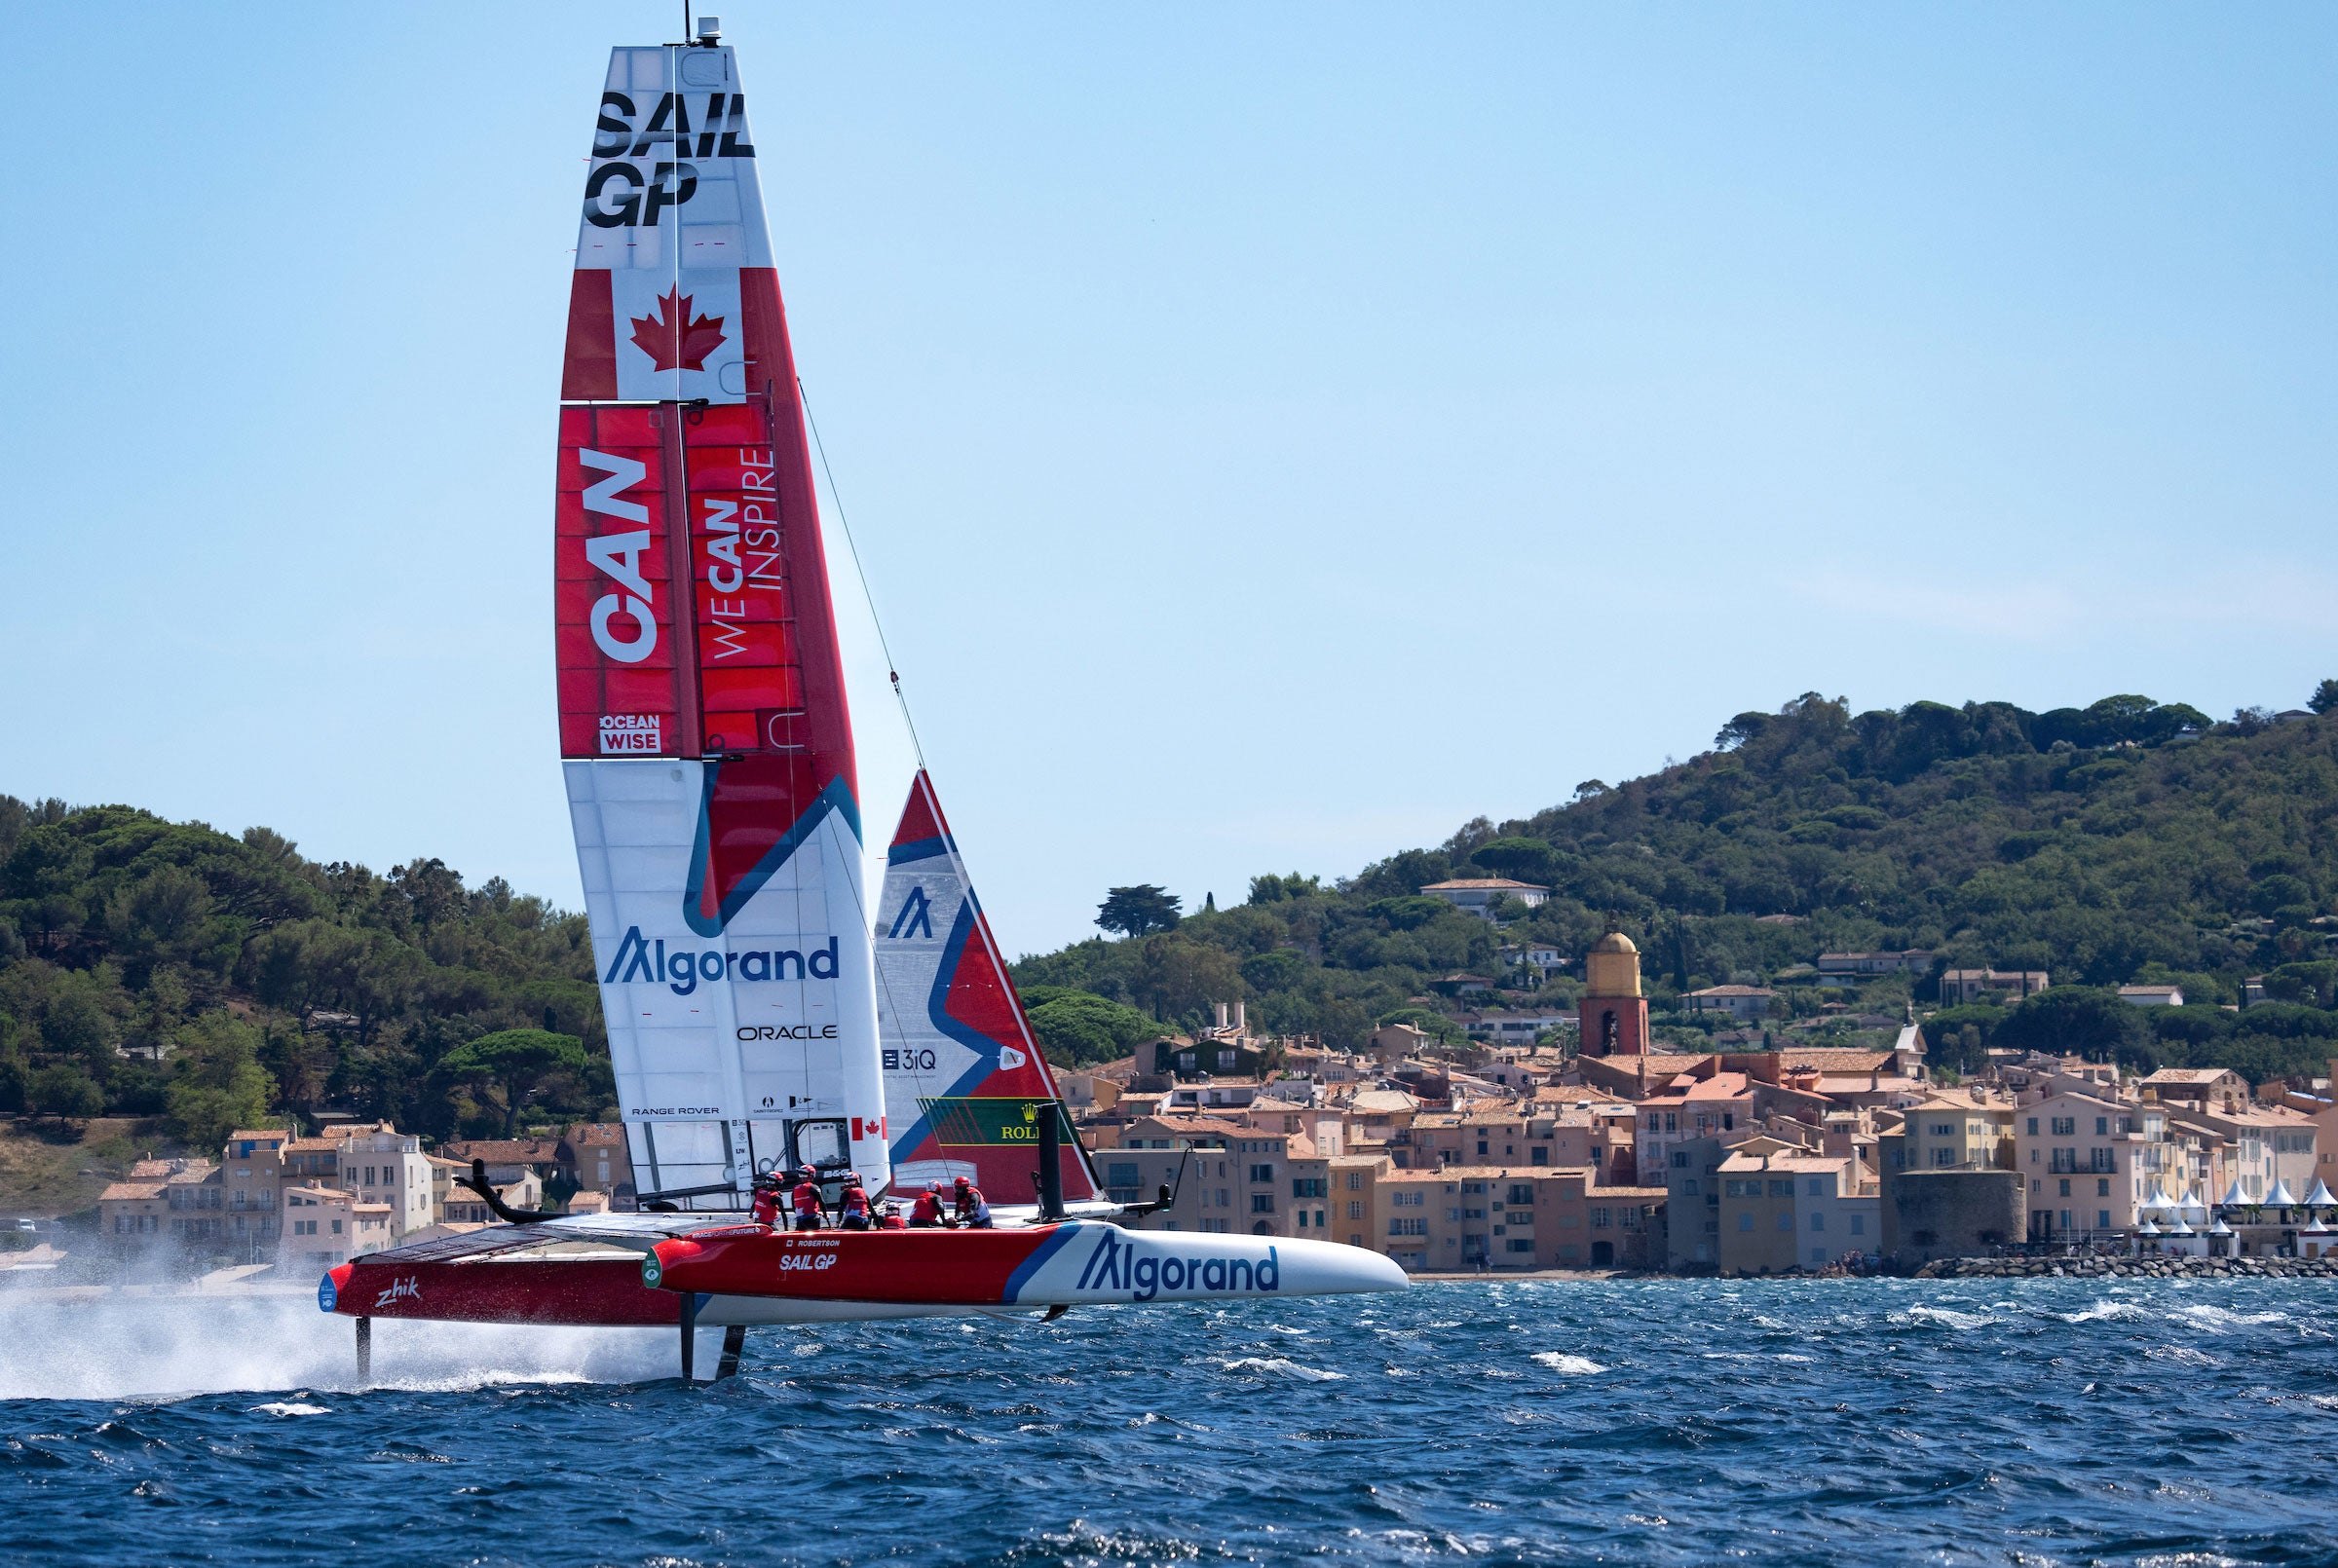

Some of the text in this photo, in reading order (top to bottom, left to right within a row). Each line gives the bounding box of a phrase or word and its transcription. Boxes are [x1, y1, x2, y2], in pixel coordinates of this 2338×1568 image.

[592, 92, 756, 159] SAIL
[584, 162, 700, 229] GP
[739, 448, 782, 590] INSPIRE
[579, 447, 658, 663] CAN
[704, 498, 748, 659] WE CAN
[600, 715, 660, 729] OCEAN
[604, 733, 658, 750] WISE
[604, 925, 840, 996] Algorand
[736, 1025, 838, 1041] ORACLE
[902, 1049, 936, 1070] 3iQ
[823, 1169, 849, 1178] B&G
[375, 1276, 421, 1307] zhik
[1075, 1228, 1279, 1302] Algorand
